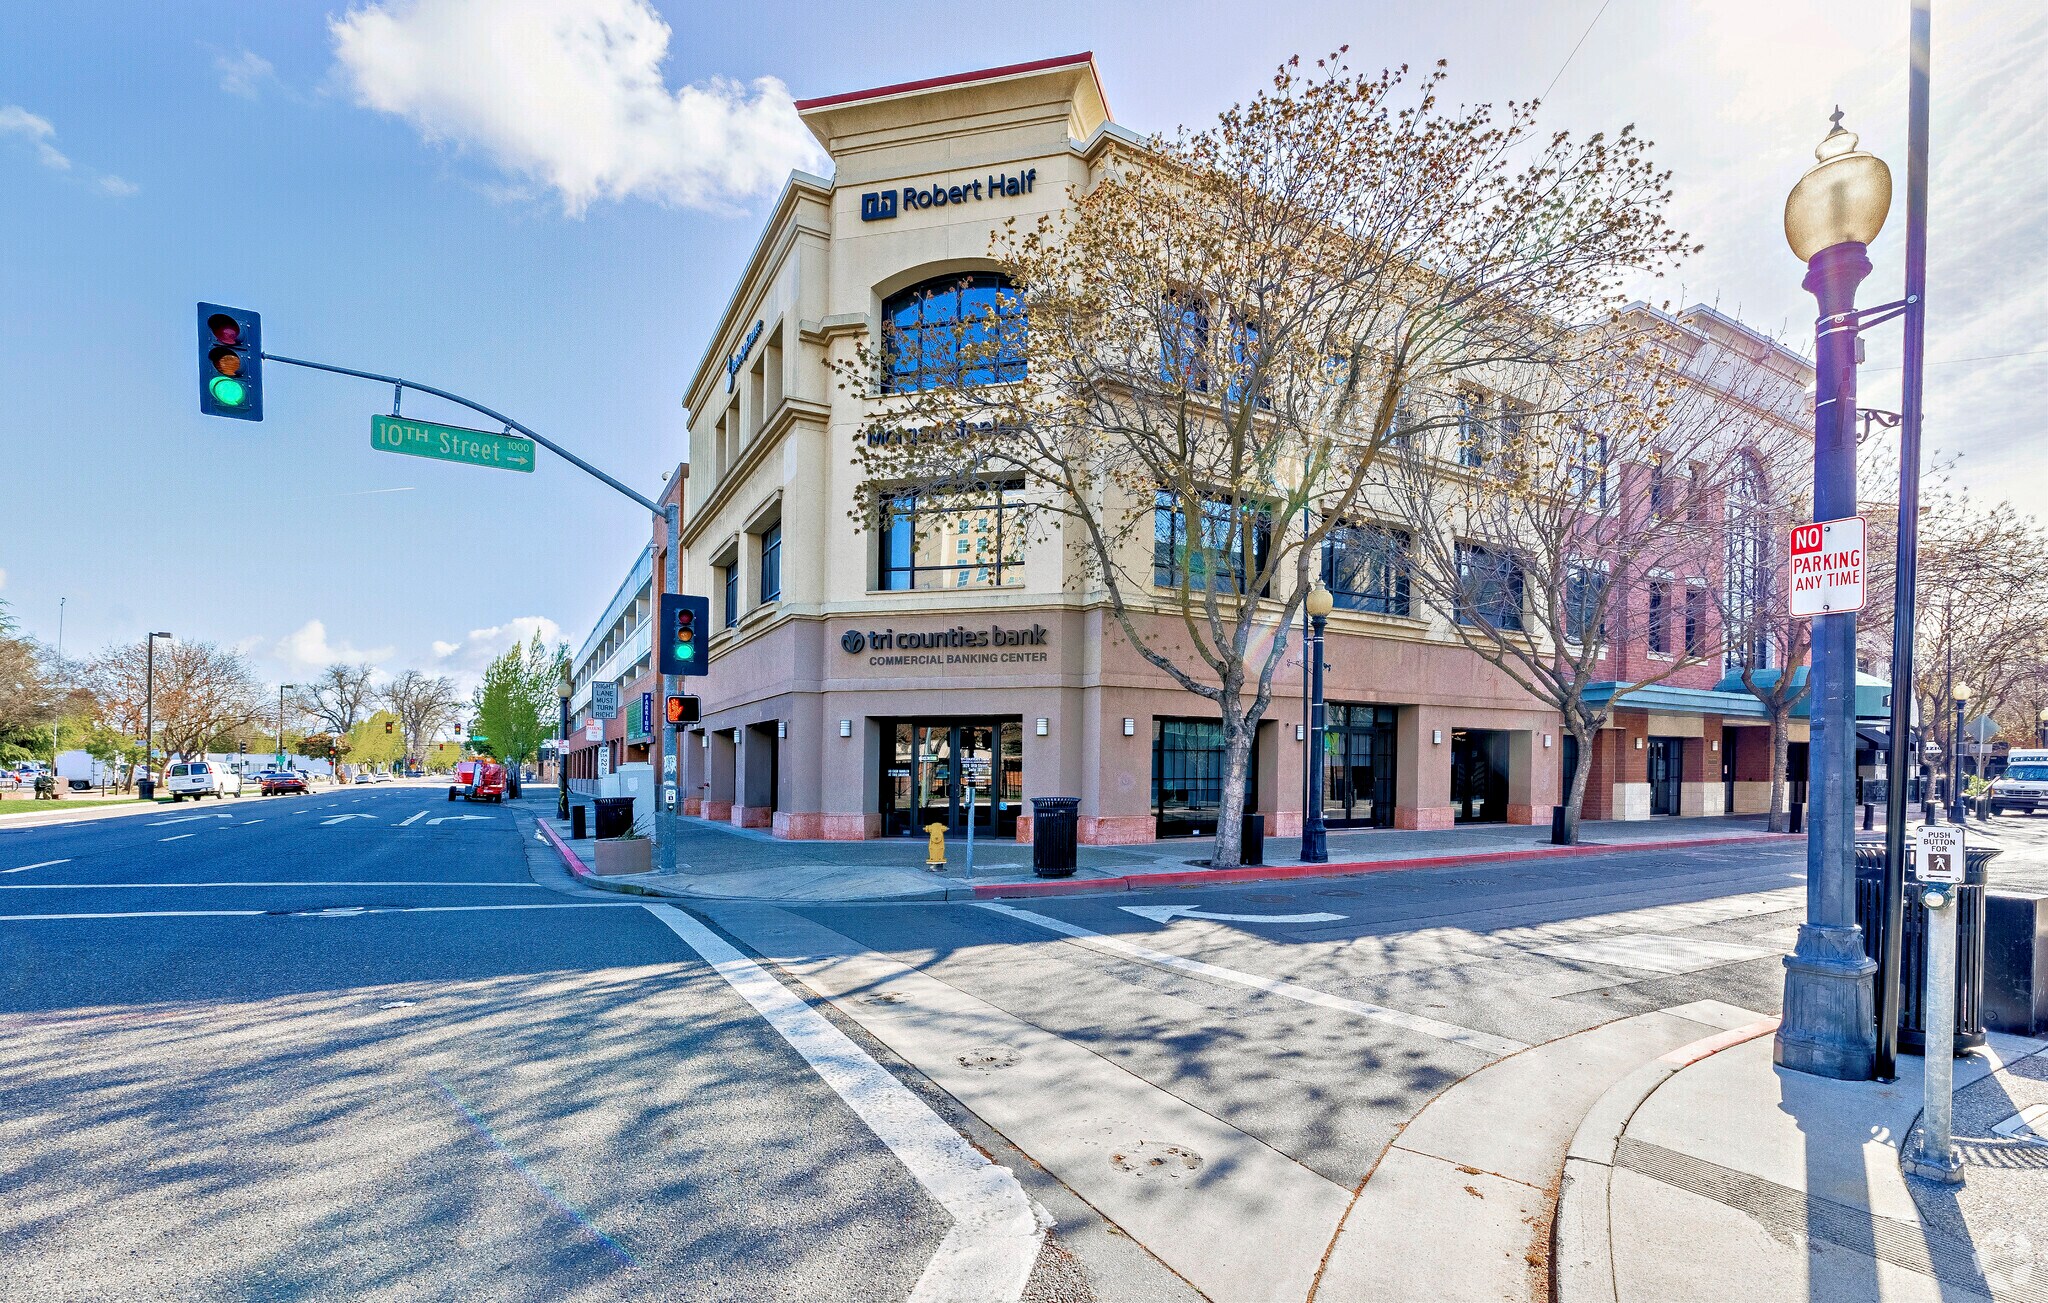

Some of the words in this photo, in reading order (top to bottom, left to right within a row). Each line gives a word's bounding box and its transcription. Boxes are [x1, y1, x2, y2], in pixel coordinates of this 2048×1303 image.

[903, 179, 982, 211] Robert
[988, 168, 1036, 199] Half
[379, 423, 429, 446] 10TH
[439, 432, 500, 461] Street
[507, 441, 530, 453] 1000
[1796, 528, 1820, 549] NO
[1794, 549, 1860, 574] PARKING
[1796, 575, 1822, 591] ANY
[1827, 570, 1860, 587] TIME
[868, 628, 893, 650] tri
[895, 626, 988, 650] counties
[992, 624, 1047, 647] bank
[869, 655, 943, 666] COMMERCIAL
[946, 653, 998, 663] BANKING
[1000, 652, 1047, 663] CENTER
